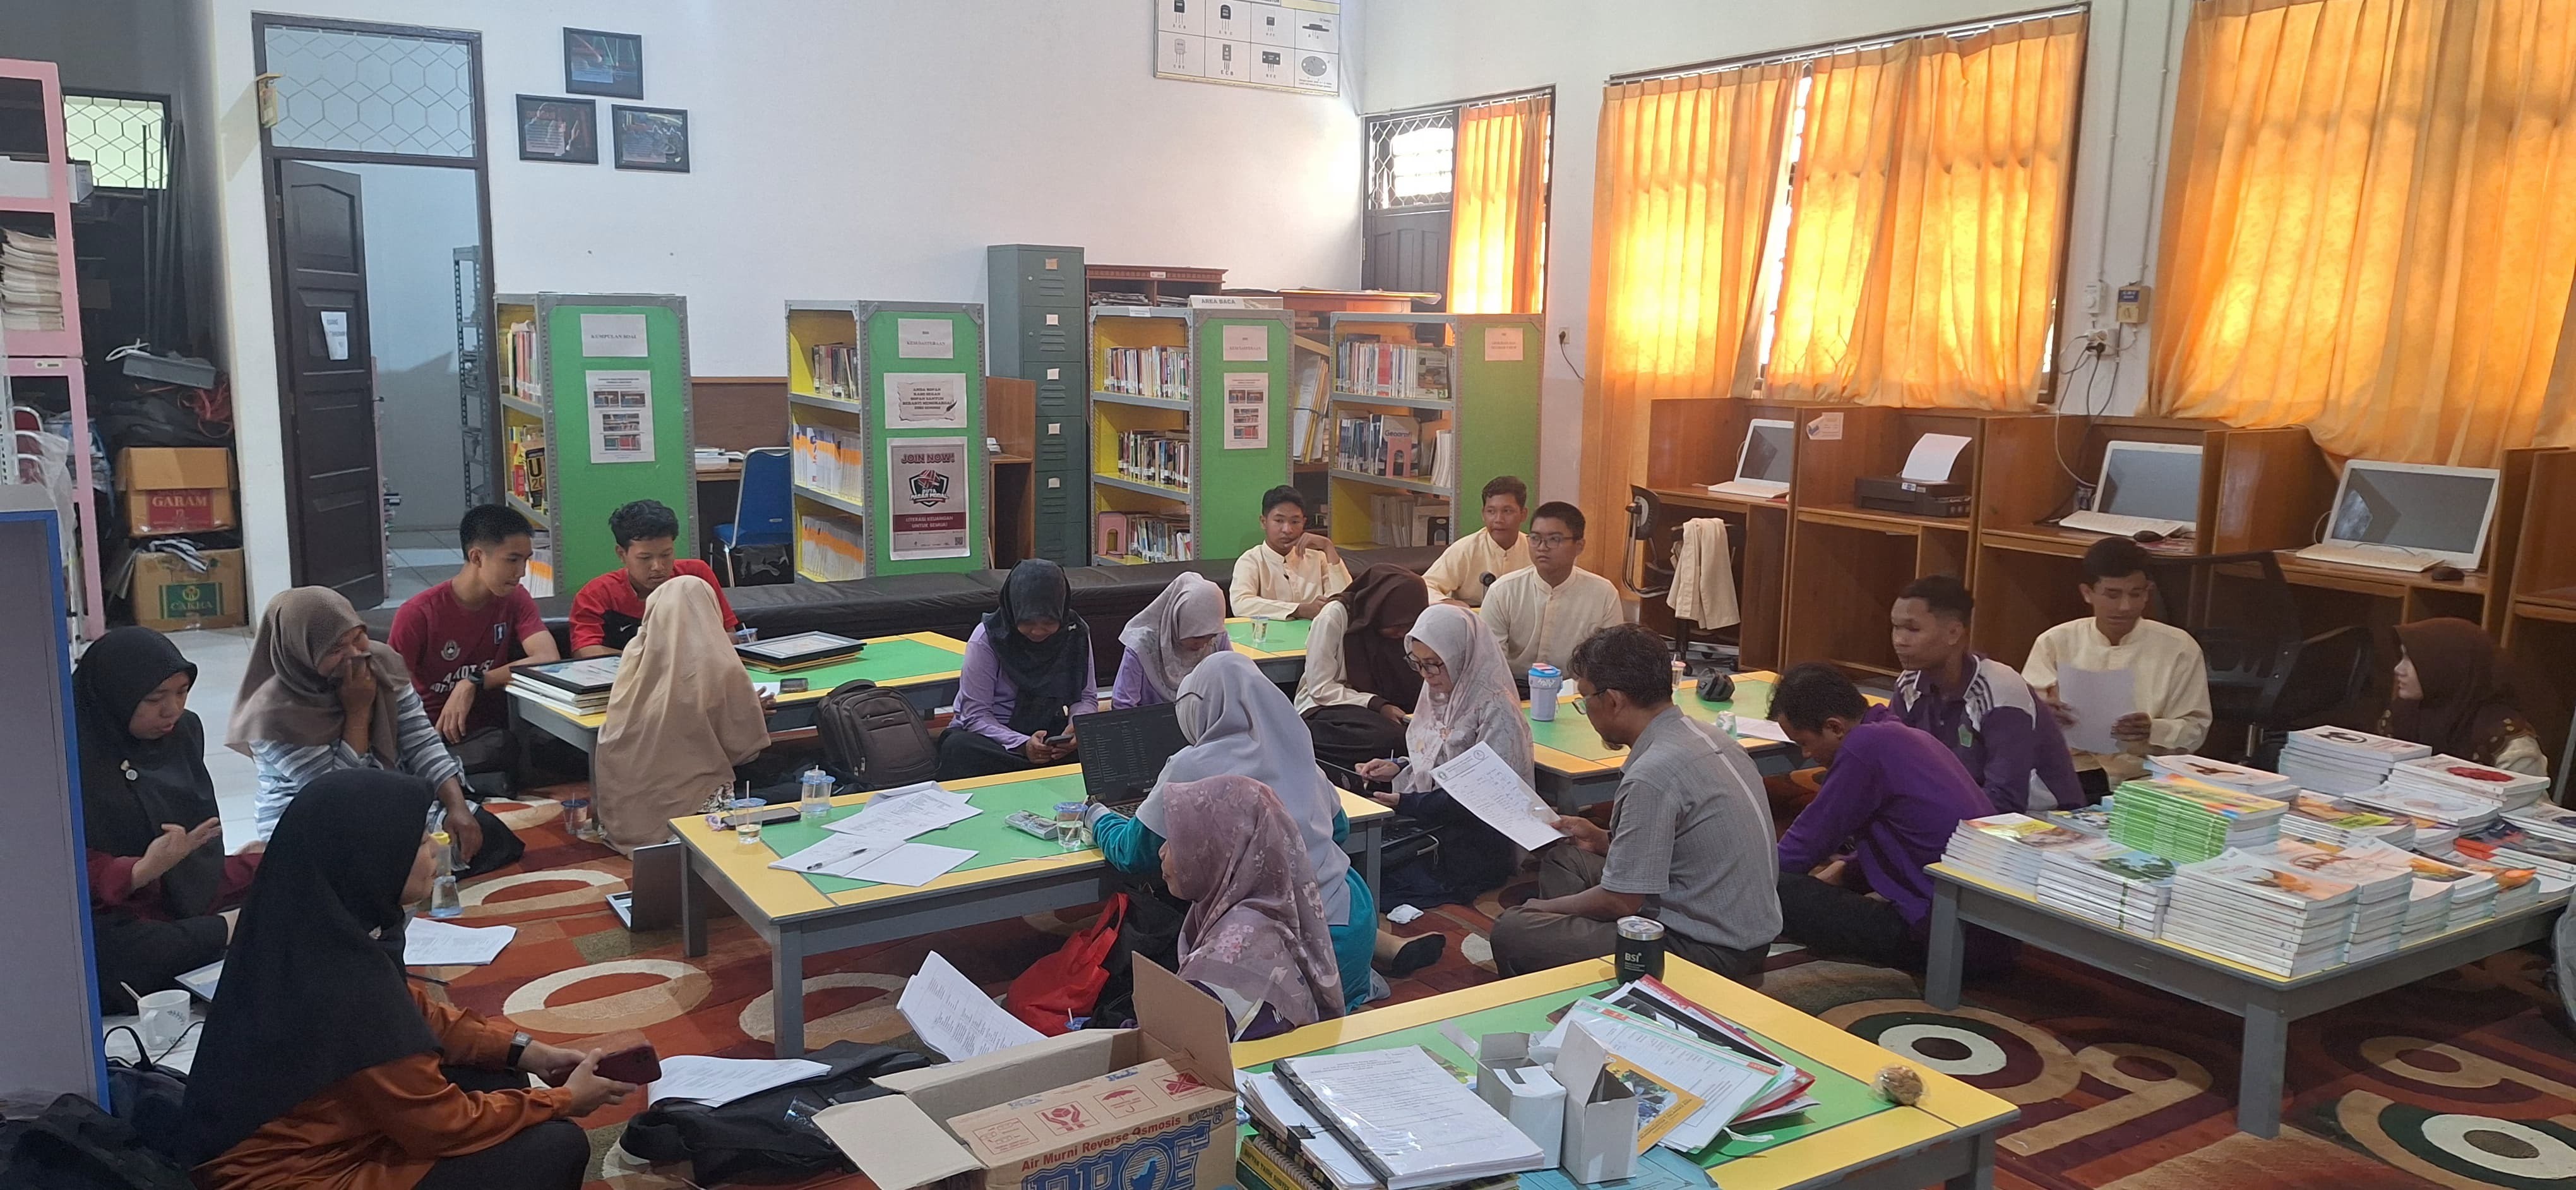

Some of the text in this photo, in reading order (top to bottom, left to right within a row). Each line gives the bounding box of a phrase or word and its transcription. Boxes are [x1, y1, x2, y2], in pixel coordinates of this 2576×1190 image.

[901, 452, 955, 464] JOIN NOW!
[152, 495, 206, 507] GARAM
[1022, 1116, 1181, 1172] Air Murni Reverse Osmosis
